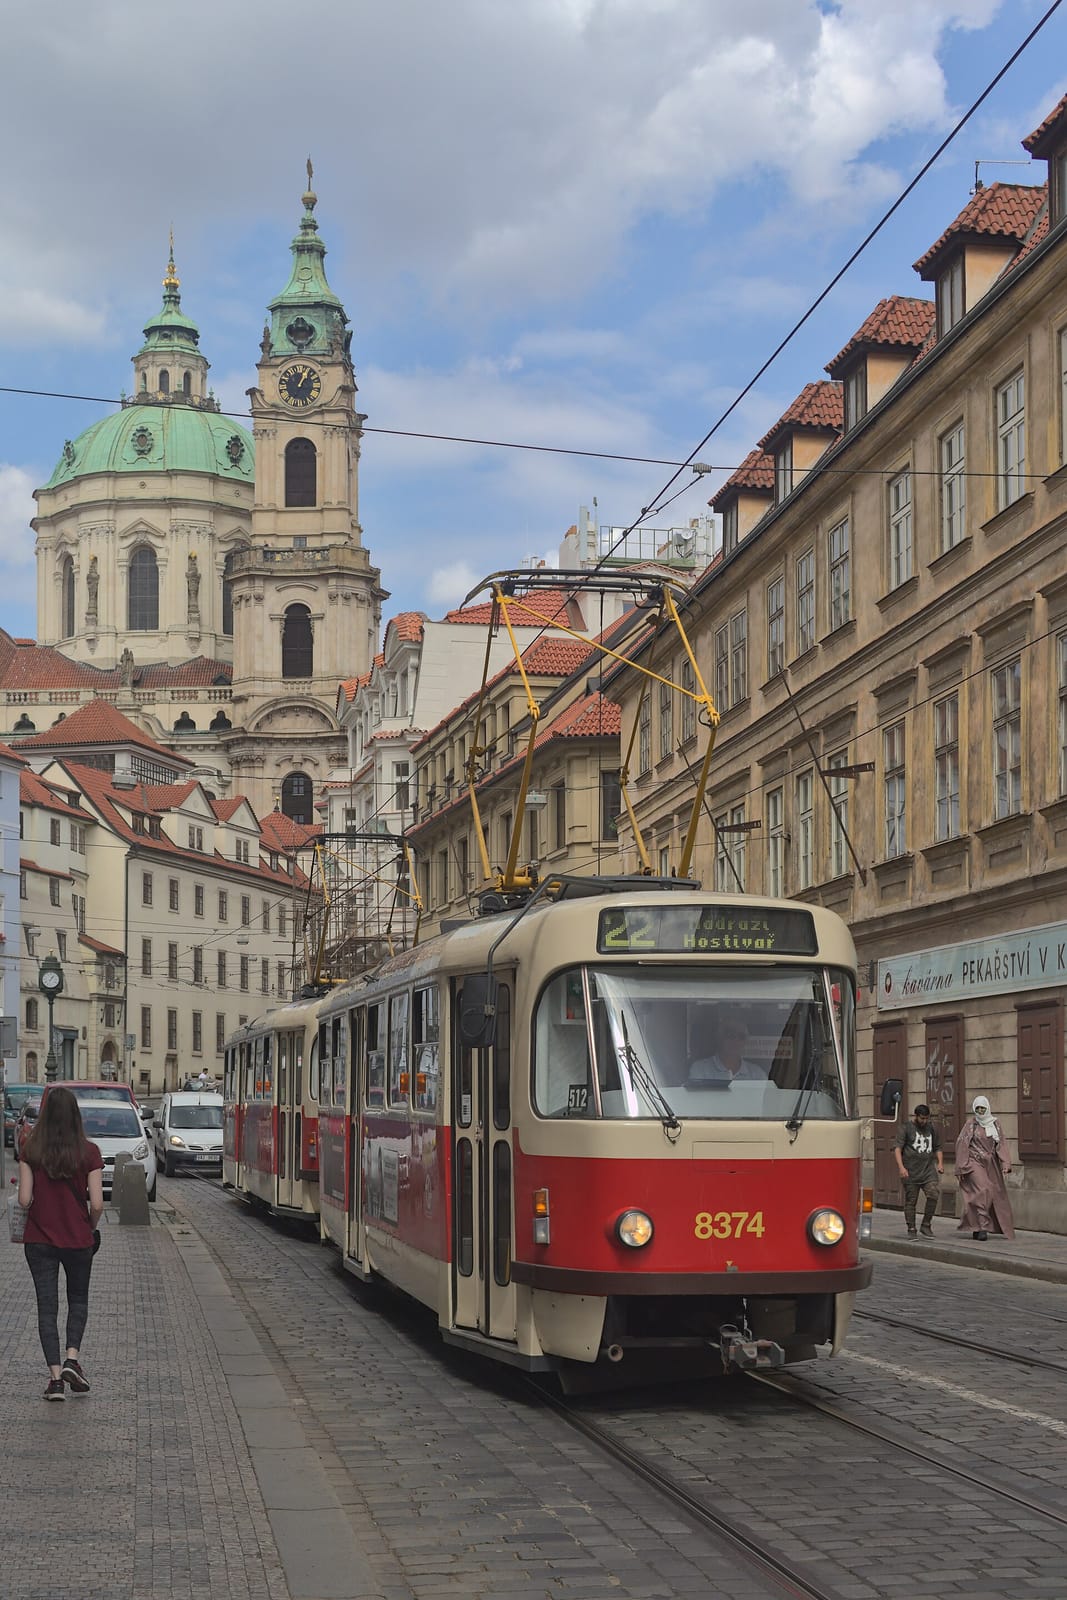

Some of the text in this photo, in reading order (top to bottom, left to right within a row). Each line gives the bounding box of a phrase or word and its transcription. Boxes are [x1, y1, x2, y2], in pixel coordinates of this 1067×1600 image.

[604, 912, 655, 947] 22
[683, 933, 775, 949] Hostivař
[902, 965, 953, 995] kavárna
[962, 942, 1031, 985] PEKAŘSTVÍ
[1039, 947, 1048, 973] V
[570, 1089, 587, 1108] 512
[694, 1212, 765, 1239] 8374
